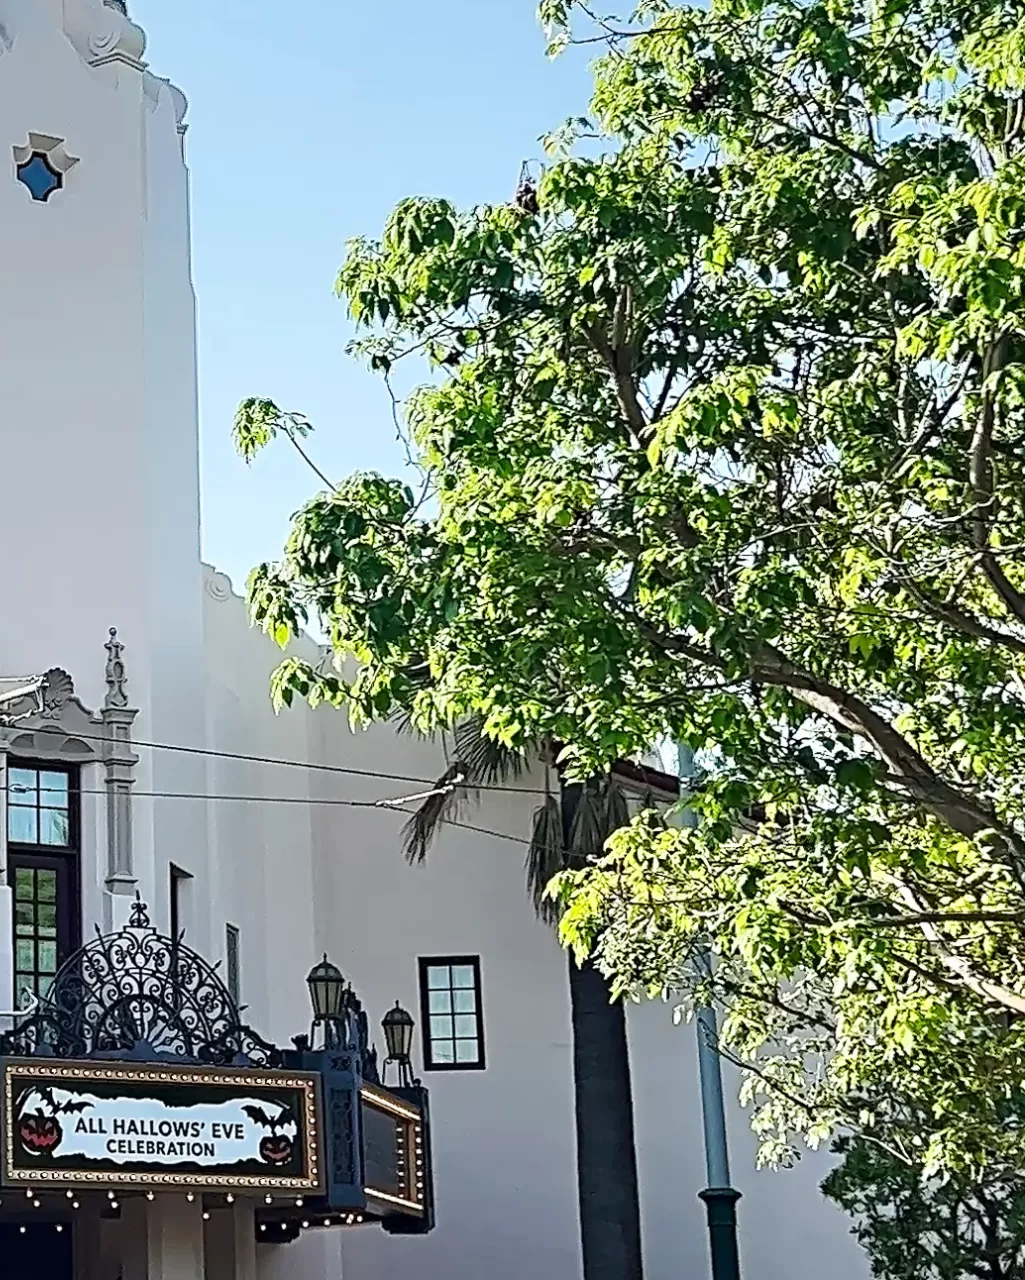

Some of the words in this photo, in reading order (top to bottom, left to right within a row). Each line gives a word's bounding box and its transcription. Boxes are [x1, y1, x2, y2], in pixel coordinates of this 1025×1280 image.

[75, 1117, 107, 1134] ALL
[113, 1118, 205, 1138] HALLOWS'
[212, 1122, 244, 1139] EVE
[106, 1139, 215, 1157] CELEBRATION
